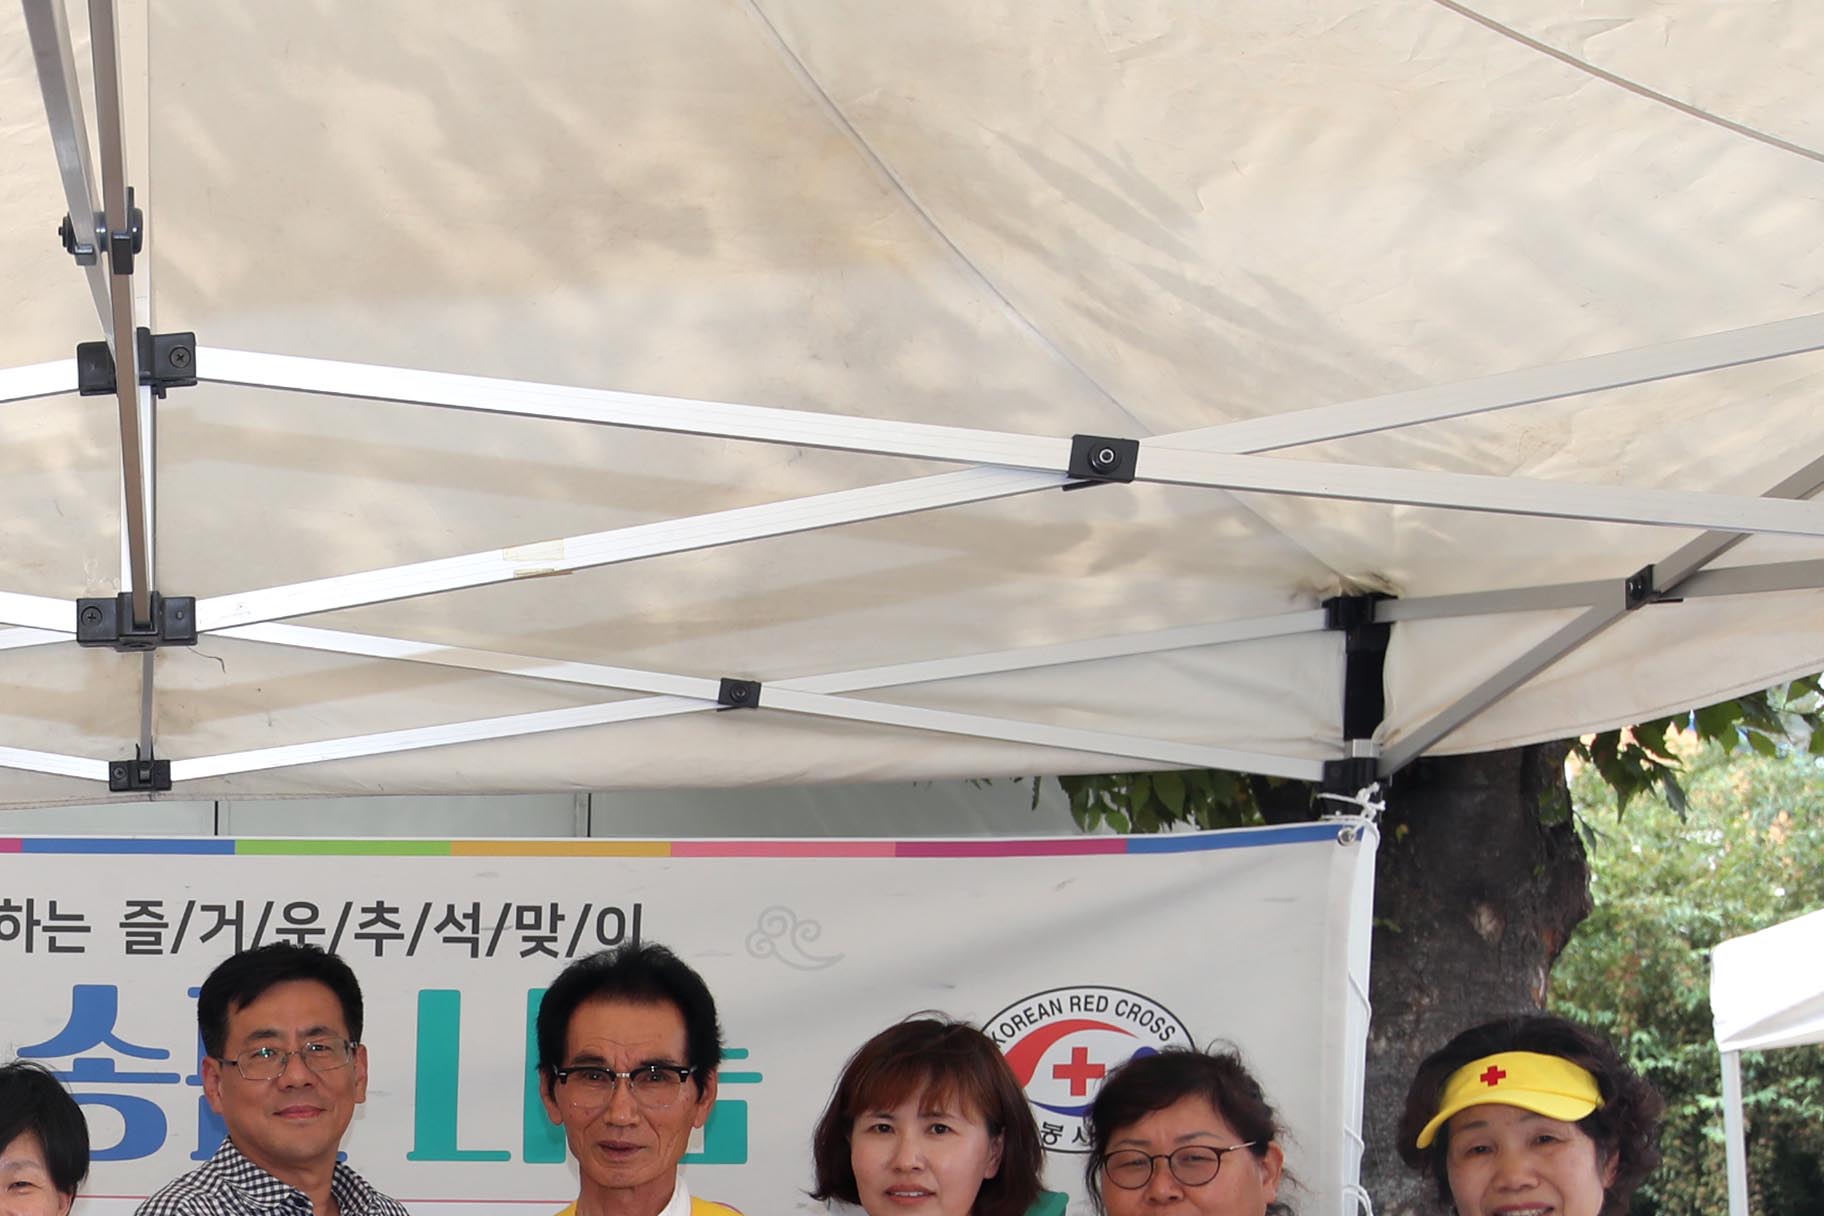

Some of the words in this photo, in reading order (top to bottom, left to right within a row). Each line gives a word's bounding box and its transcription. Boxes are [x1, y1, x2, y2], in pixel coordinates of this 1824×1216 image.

[991, 998, 1063, 1046] KOREAN
[1070, 995, 1108, 1012] RED
[1114, 999, 1176, 1042] CROSS
